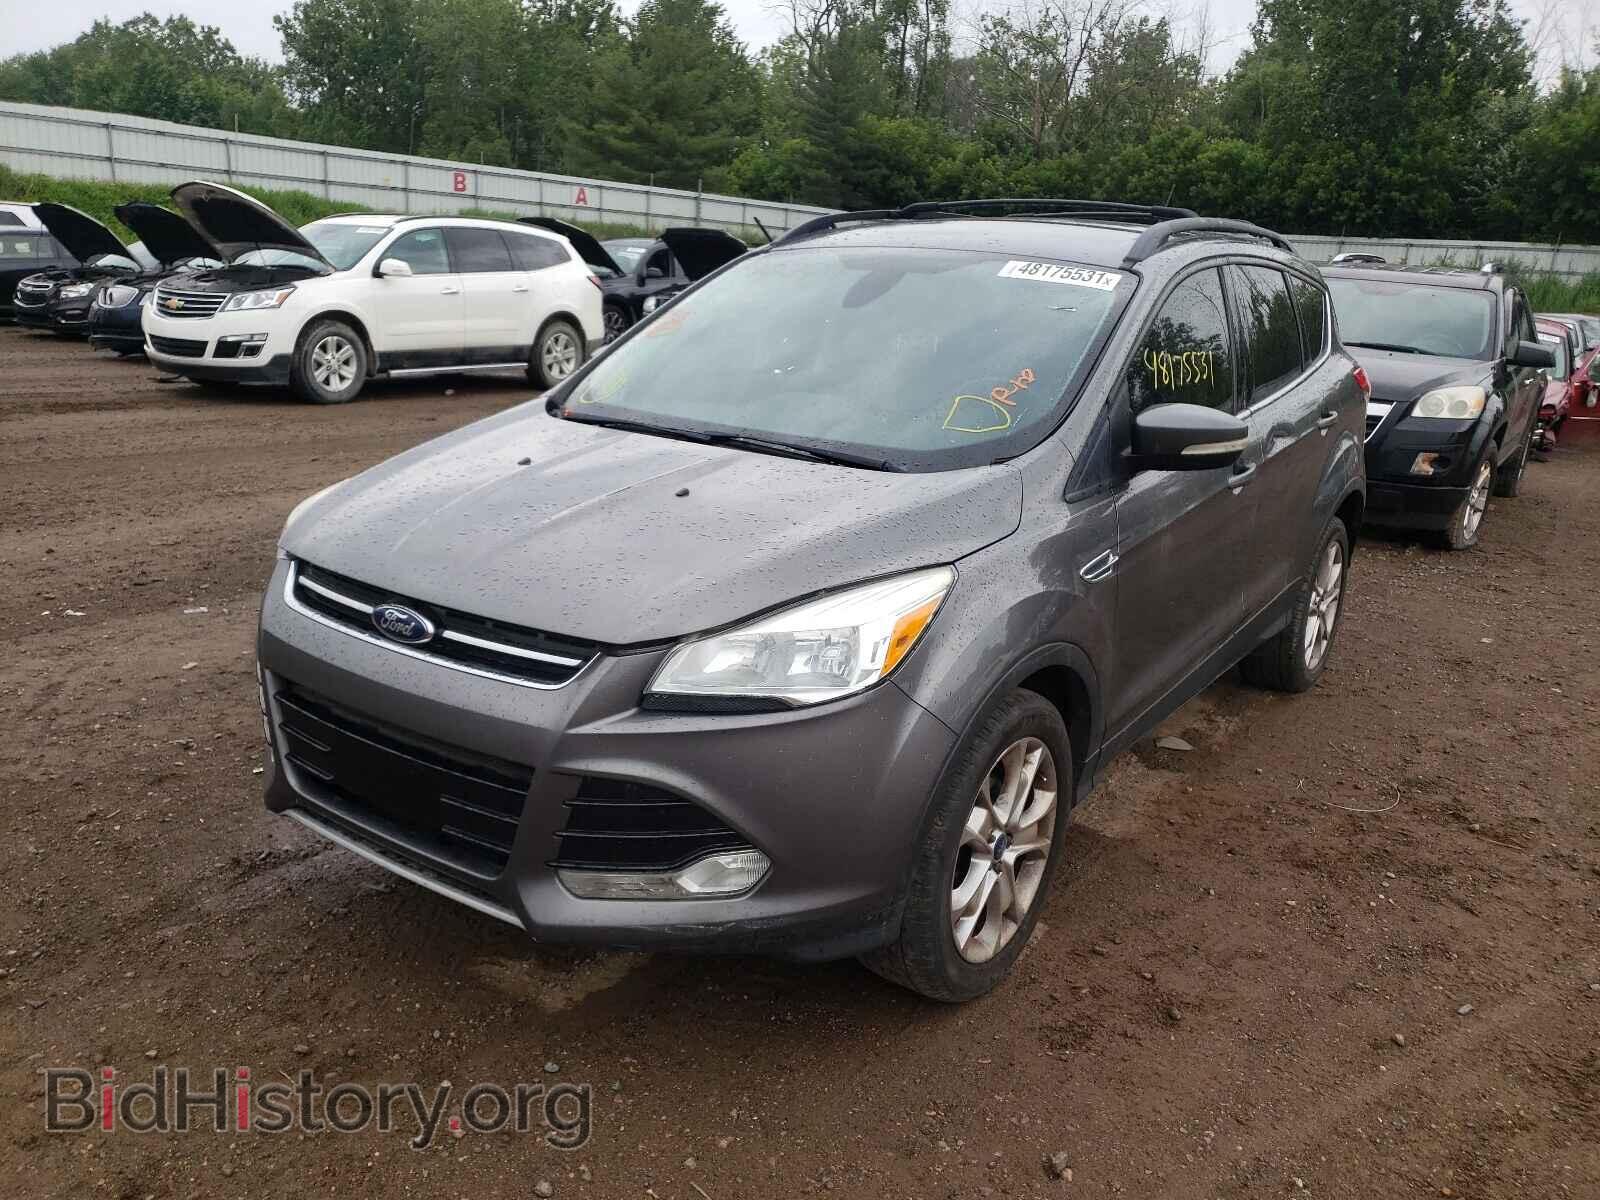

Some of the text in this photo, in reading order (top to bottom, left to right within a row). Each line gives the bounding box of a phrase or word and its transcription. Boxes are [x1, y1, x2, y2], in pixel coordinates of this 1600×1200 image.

[454, 171, 467, 193] B
[575, 186, 588, 206] A
[1143, 346, 1216, 392] 48175531
[379, 608, 416, 637] Ford
